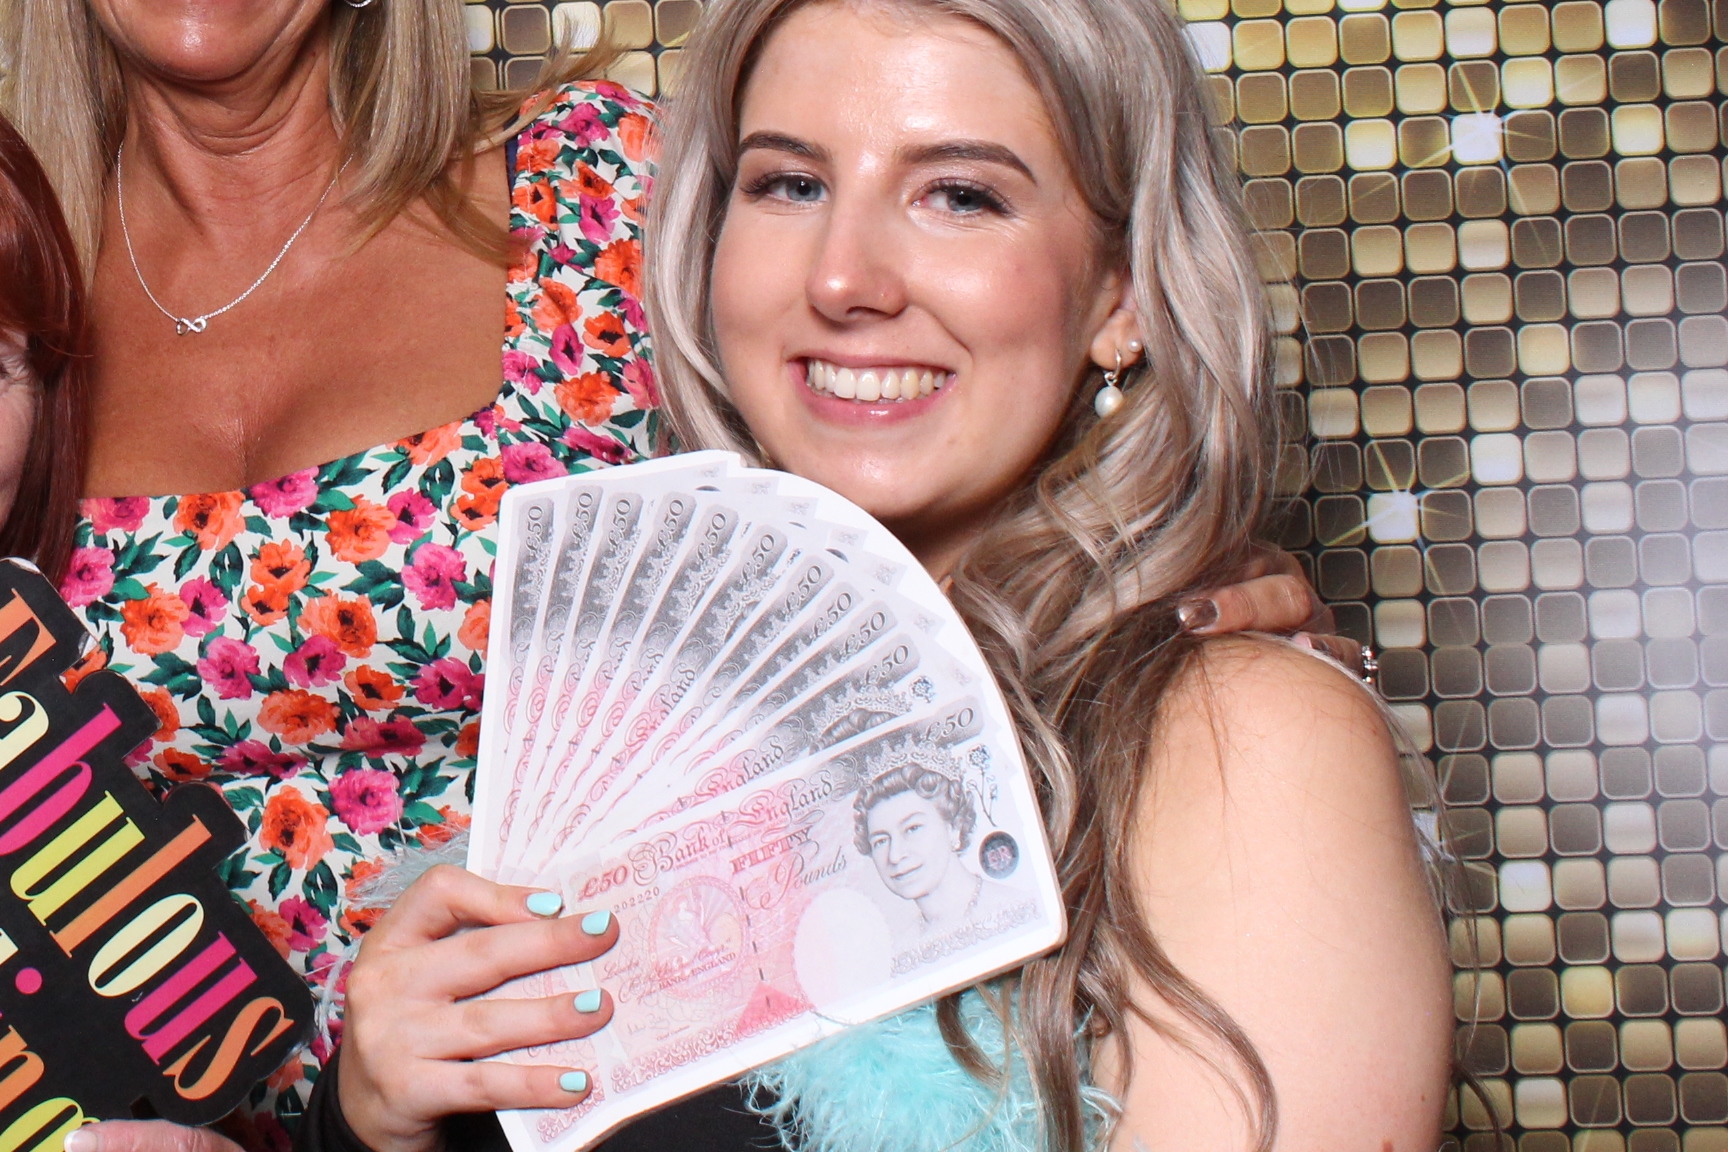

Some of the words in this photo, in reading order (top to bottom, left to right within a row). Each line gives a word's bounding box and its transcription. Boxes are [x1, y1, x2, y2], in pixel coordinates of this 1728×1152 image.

[525, 505, 544, 556] £50
[572, 492, 593, 542] £50
[608, 499, 632, 551] £50
[657, 499, 685, 549] £50
[697, 512, 727, 563] £50
[738, 533, 775, 585] £50
[783, 564, 822, 614] £50
[808, 592, 852, 641] £50
[840, 611, 886, 656] £50
[862, 644, 910, 687] £50
[924, 707, 974, 742] £50
[628, 824, 709, 886] Bank
[732, 769, 833, 828] England
[731, 824, 814, 876] FIFTY
[578, 865, 628, 901] £50
[747, 845, 847, 909] Pounds
